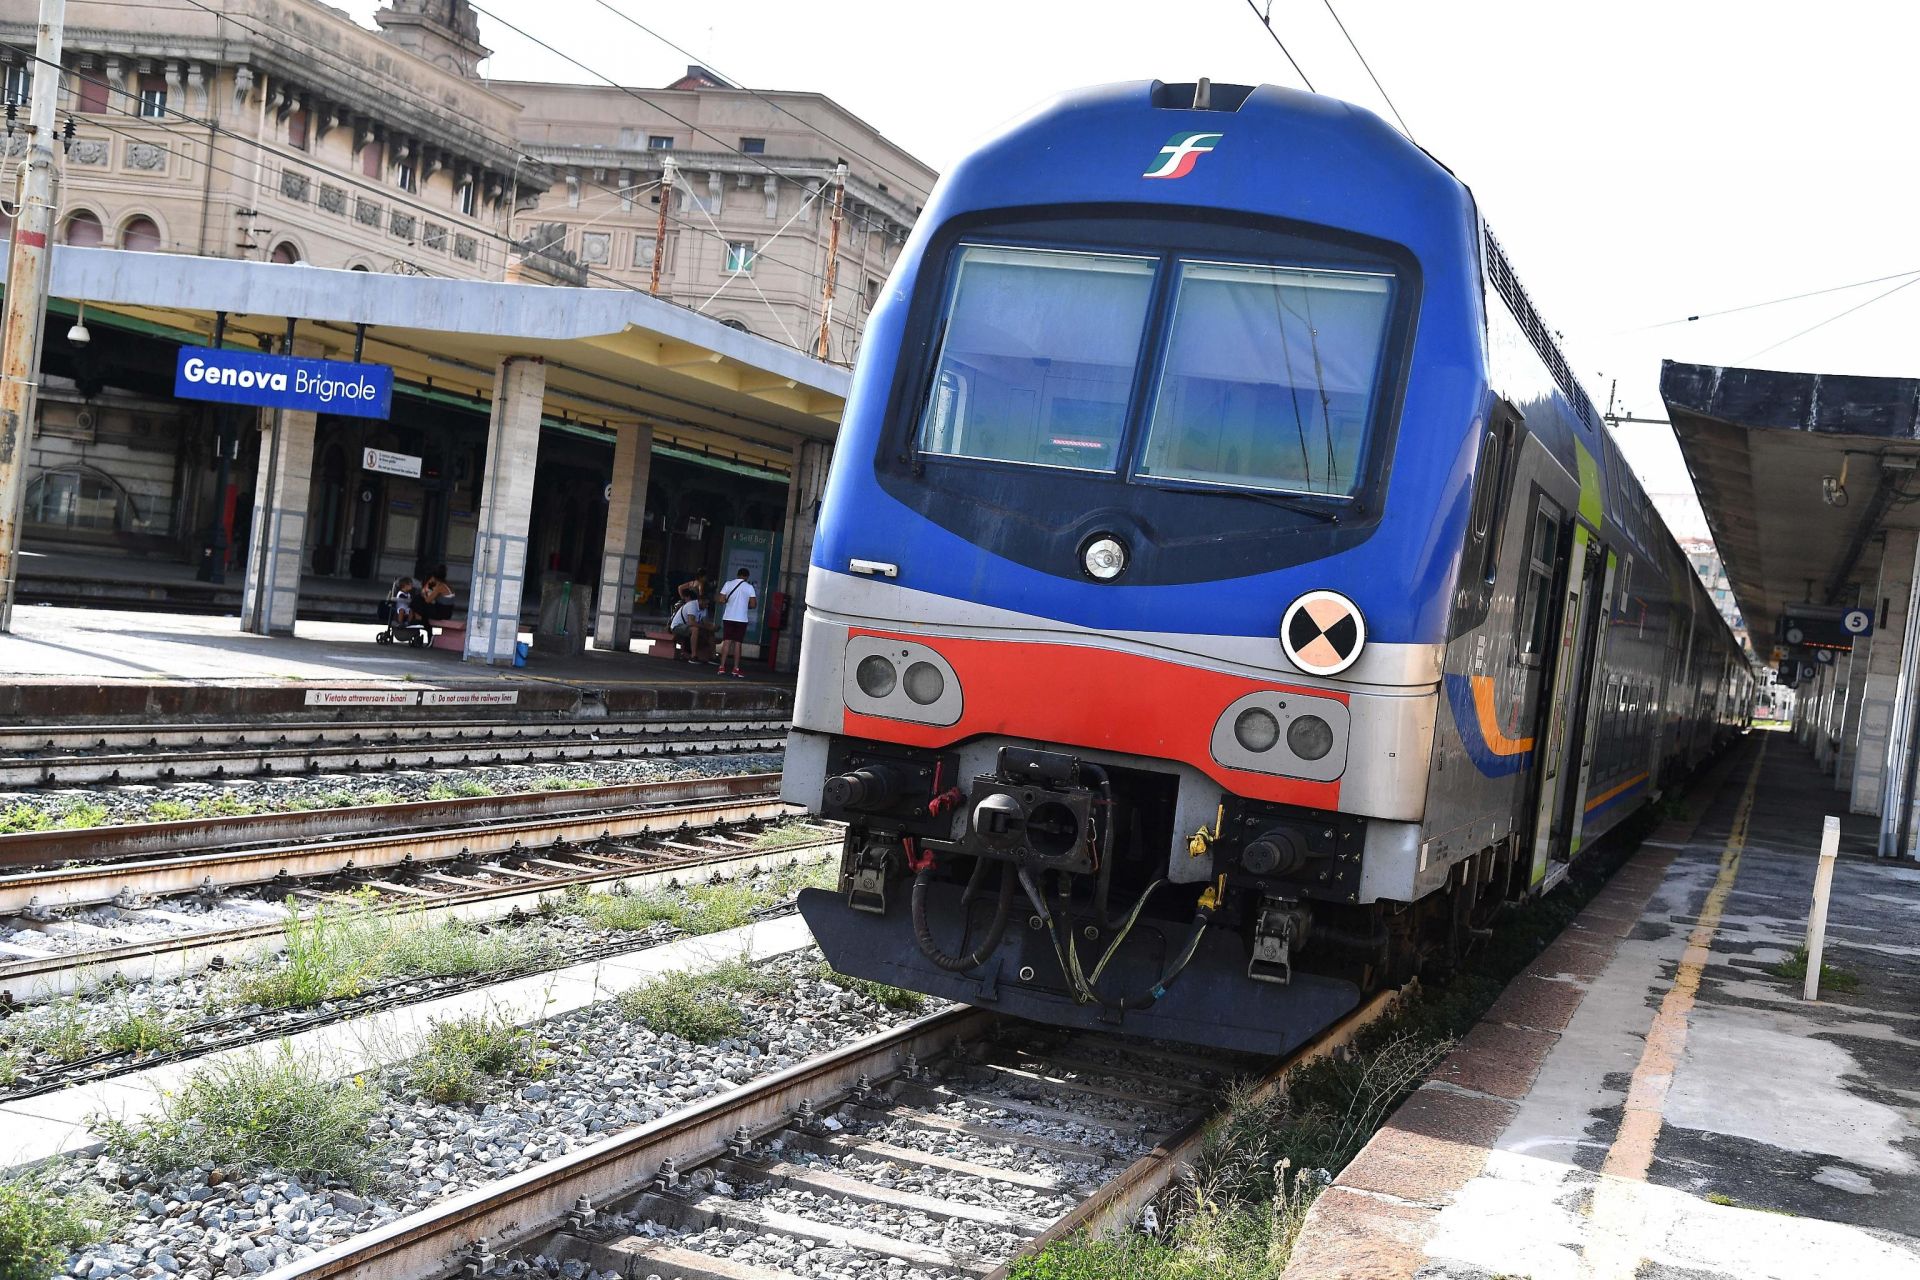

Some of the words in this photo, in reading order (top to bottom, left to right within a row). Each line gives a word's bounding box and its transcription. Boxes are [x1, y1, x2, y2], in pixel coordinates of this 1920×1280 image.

[184, 357, 288, 392] Genova
[295, 369, 376, 402] Brignole
[1851, 616, 1861, 628] 5
[324, 693, 347, 702] Vietato
[348, 693, 385, 703] attraversare
[390, 693, 408, 703] binari
[438, 694, 446, 703] Do
[446, 694, 456, 703] not
[456, 694, 470, 702] cross
[470, 693, 480, 702] the
[480, 693, 501, 704] railway
[501, 693, 512, 702] lines
